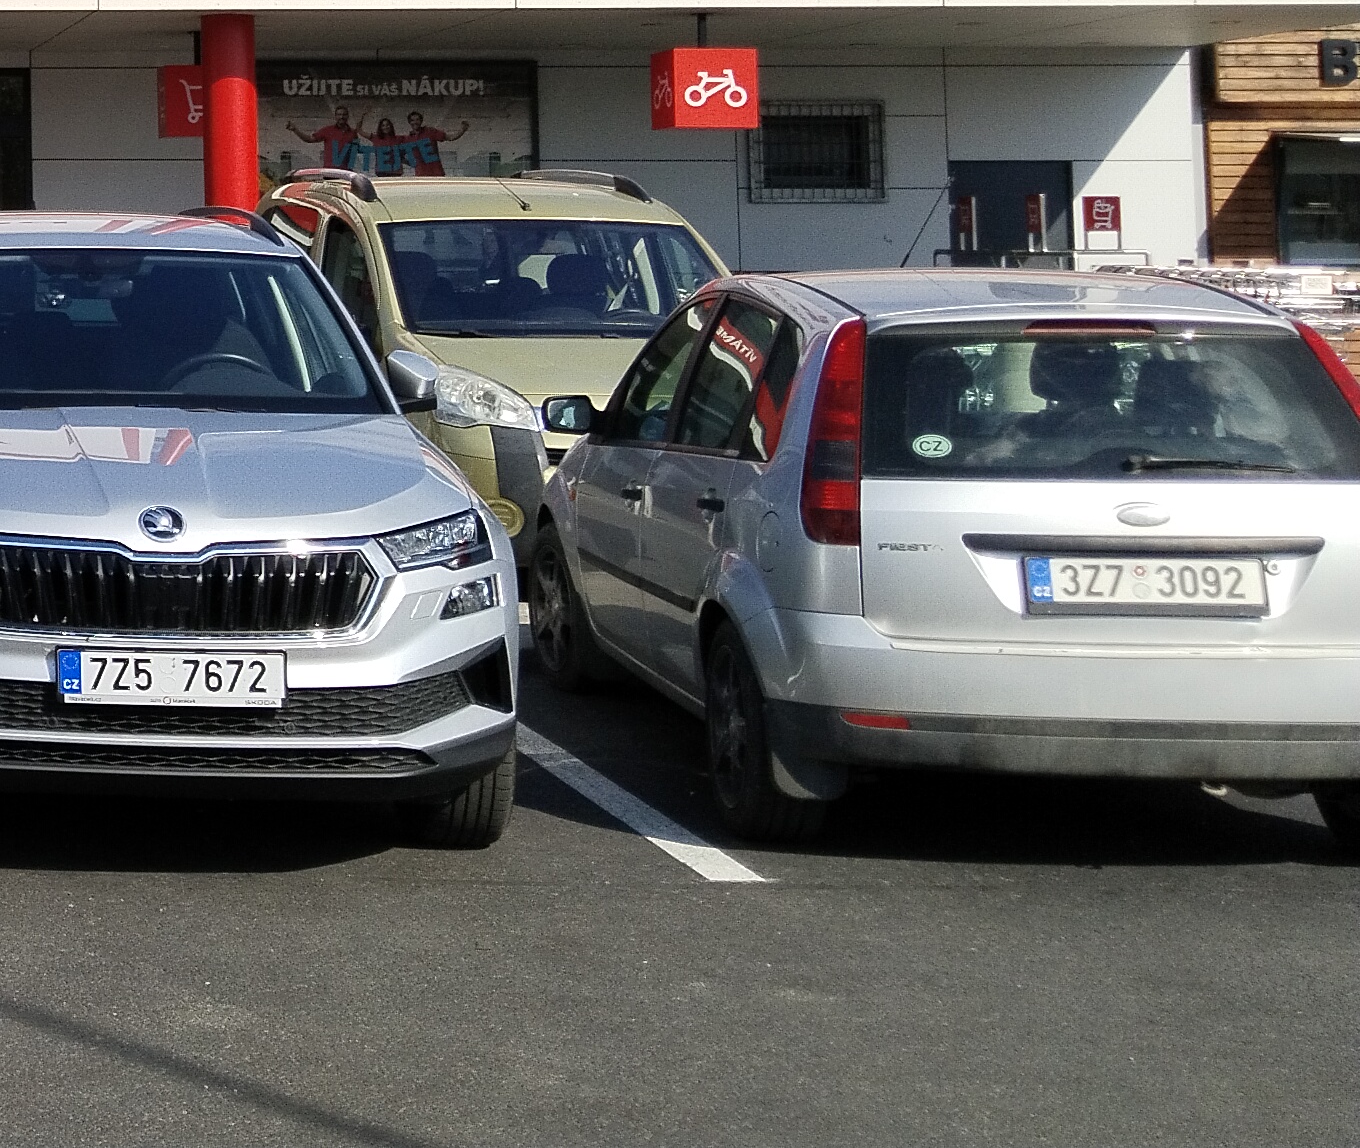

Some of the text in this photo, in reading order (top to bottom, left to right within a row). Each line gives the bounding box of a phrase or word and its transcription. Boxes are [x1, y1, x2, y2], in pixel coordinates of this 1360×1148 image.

[283, 74, 354, 97] UŽIJTE
[401, 75, 485, 97] NÁKUP!
[331, 137, 440, 173] VÍTEJTE
[919, 440, 944, 452] CZ
[1033, 586, 1052, 597] CZ
[1059, 564, 1246, 600] 3Z7 3092
[63, 678, 79, 689] CZ
[89, 657, 267, 693] 7Z5 7672
